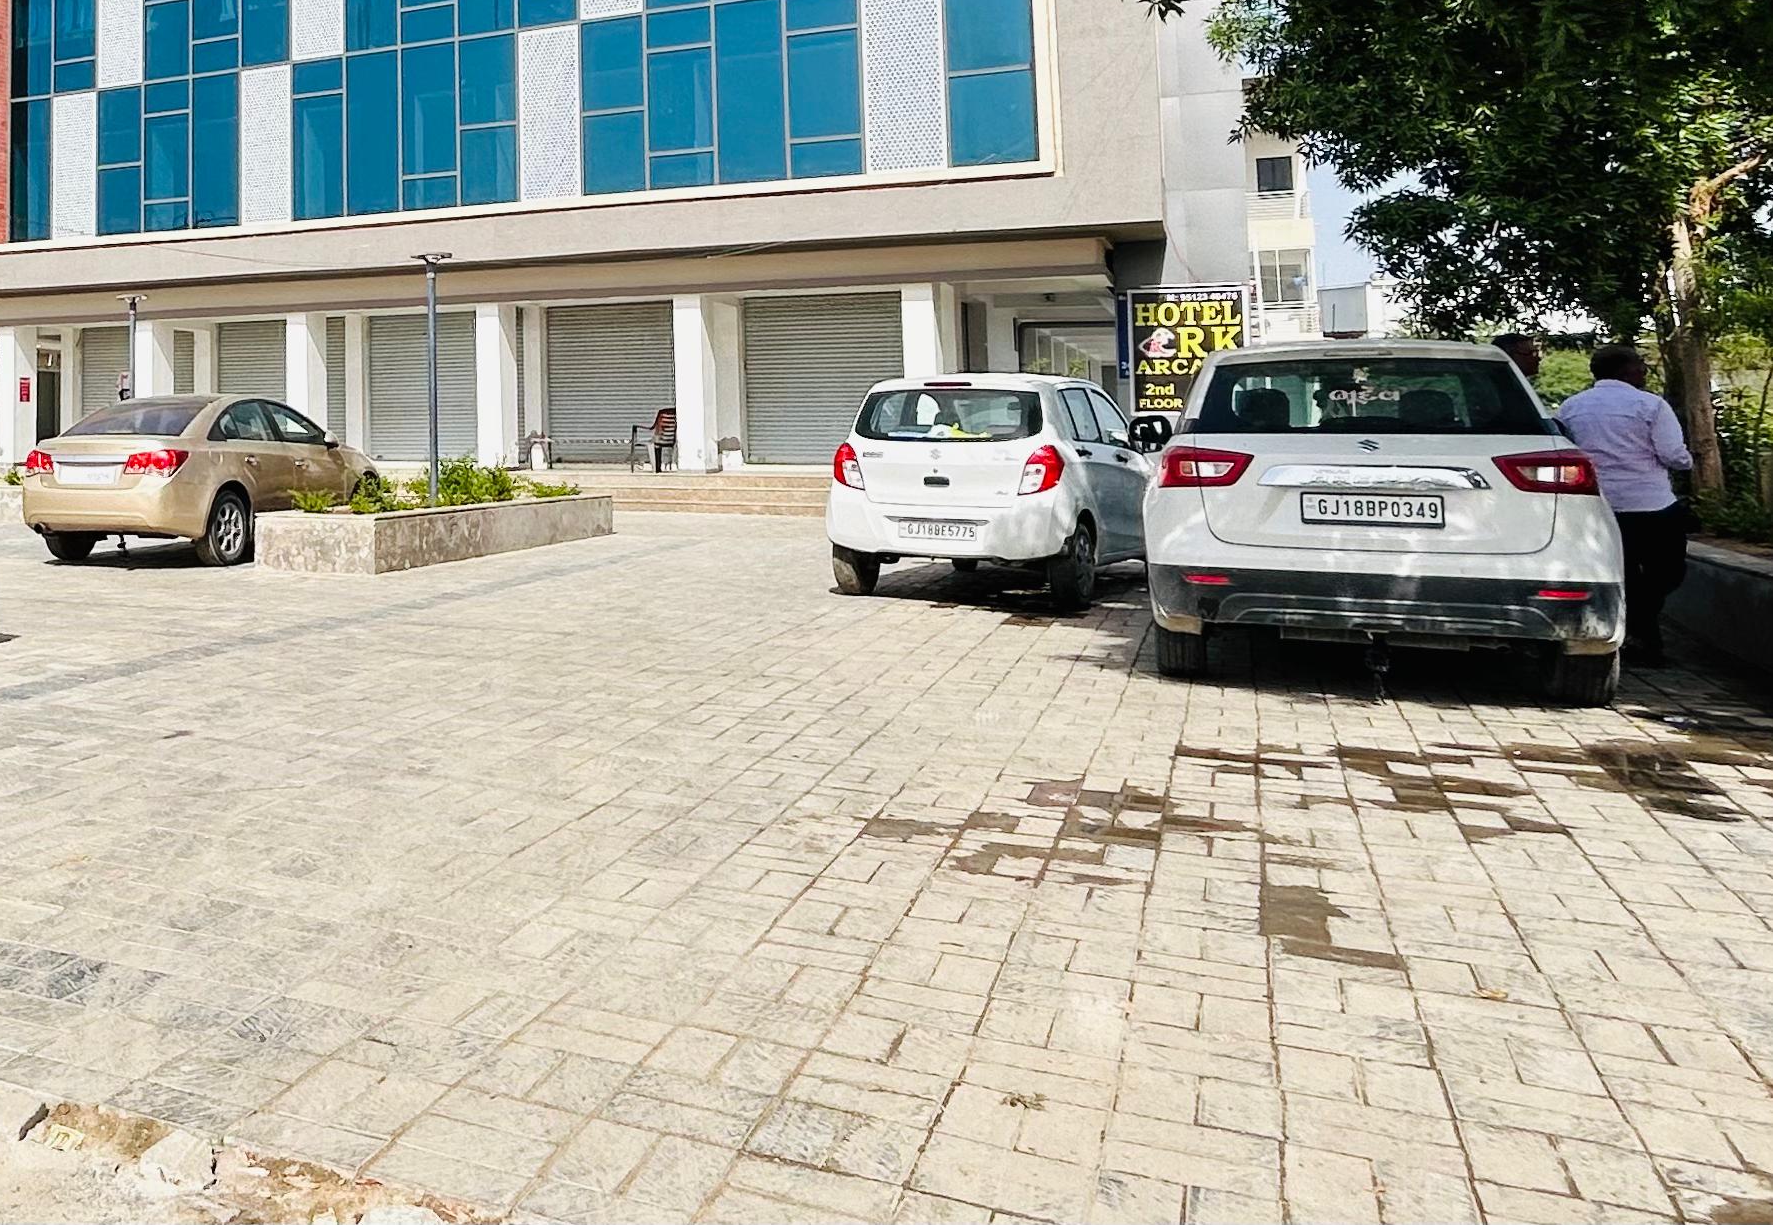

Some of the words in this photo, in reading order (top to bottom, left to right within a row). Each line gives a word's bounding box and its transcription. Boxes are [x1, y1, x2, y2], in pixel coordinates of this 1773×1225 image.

[1135, 300, 1242, 327] HOTEL
[1145, 382, 1175, 396] 2nd
[1139, 398, 1184, 409] FLOOR
[1317, 498, 1439, 519] GJ18BP0349
